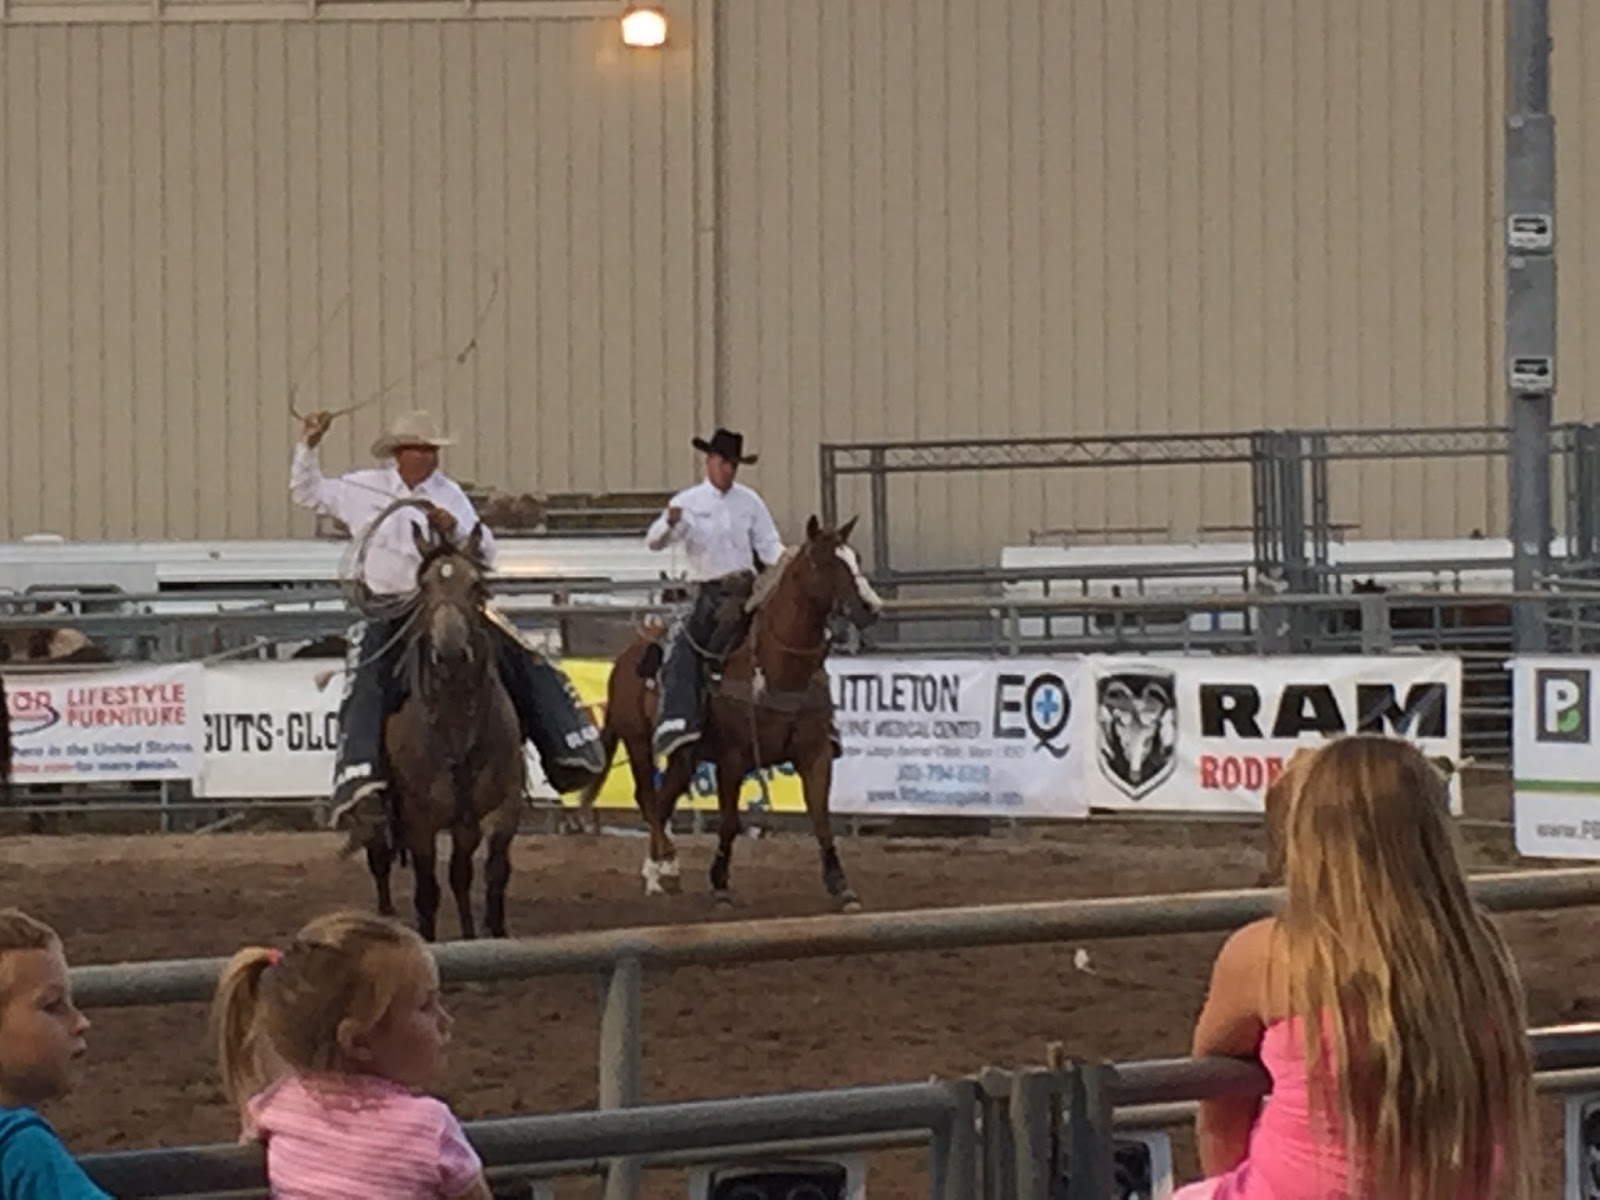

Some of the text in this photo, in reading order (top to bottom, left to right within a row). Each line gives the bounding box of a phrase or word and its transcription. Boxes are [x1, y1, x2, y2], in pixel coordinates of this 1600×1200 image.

[67, 684, 185, 706] LIFESTYLE
[67, 706, 186, 729] FURNITURE
[1200, 683, 1447, 738] RAM
